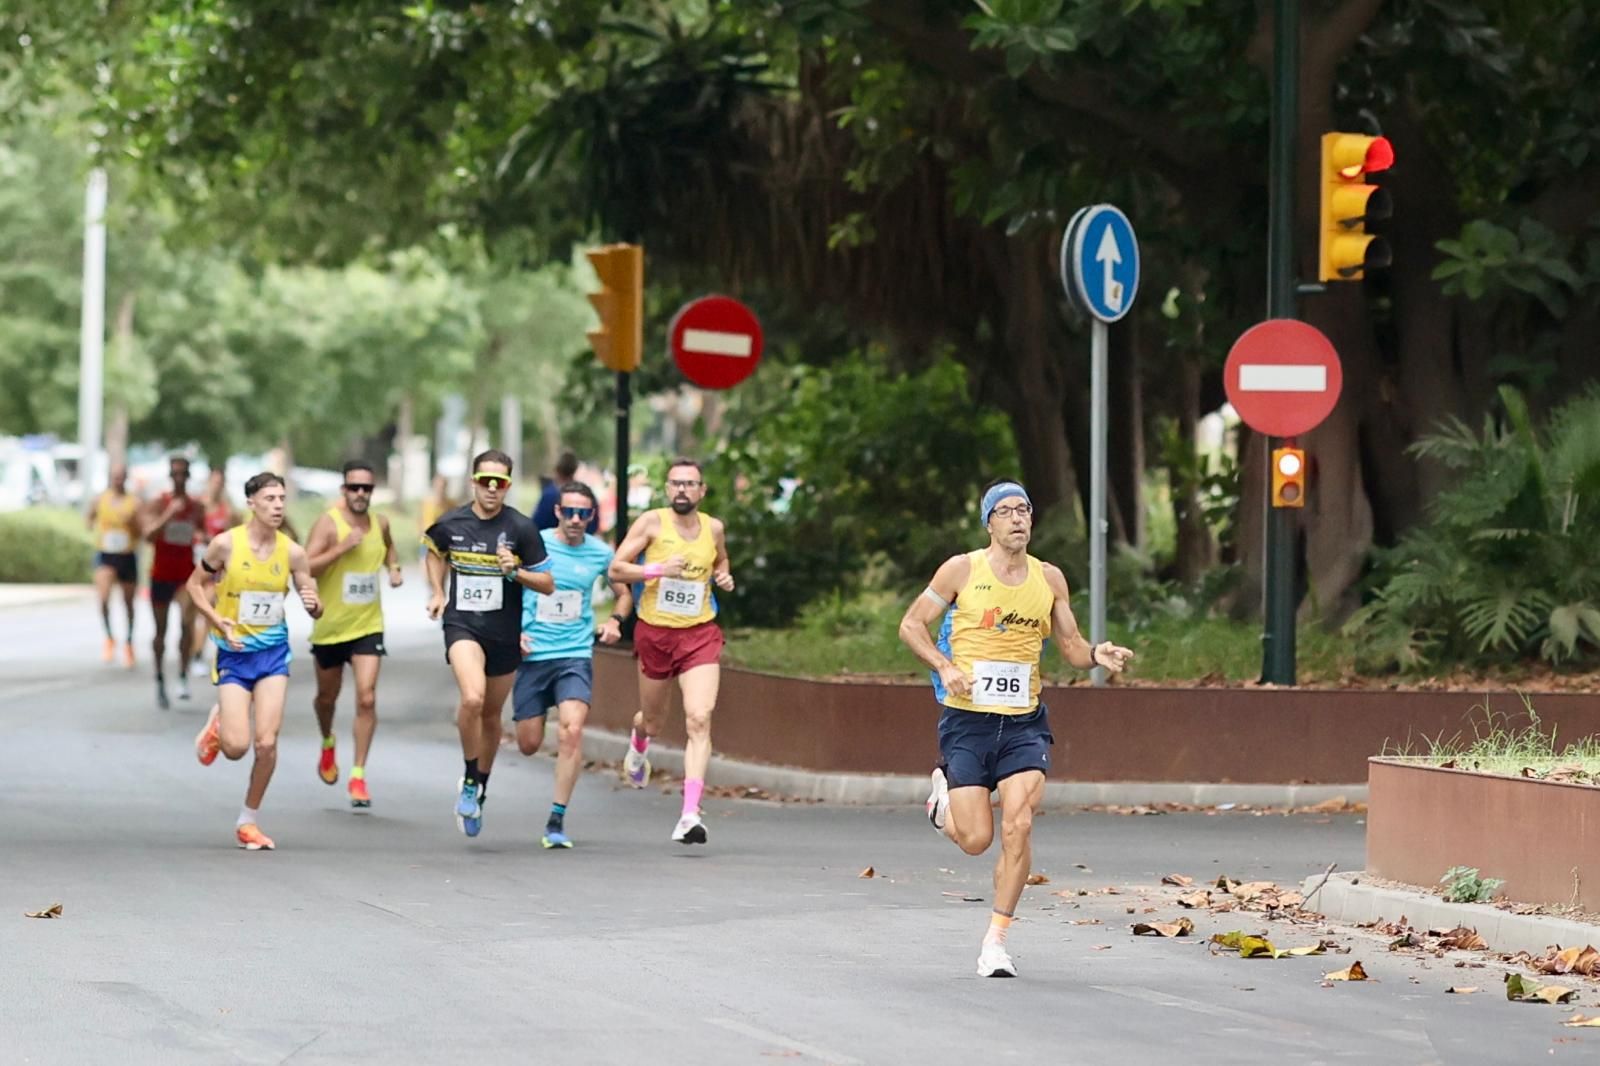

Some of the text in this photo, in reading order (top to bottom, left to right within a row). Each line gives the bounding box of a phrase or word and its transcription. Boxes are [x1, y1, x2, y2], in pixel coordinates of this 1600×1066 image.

[463, 588, 493, 600] 847
[665, 590, 696, 605] 692
[252, 603, 271, 615] 77
[555, 602, 564, 613] 1
[982, 677, 1020, 693] 796
